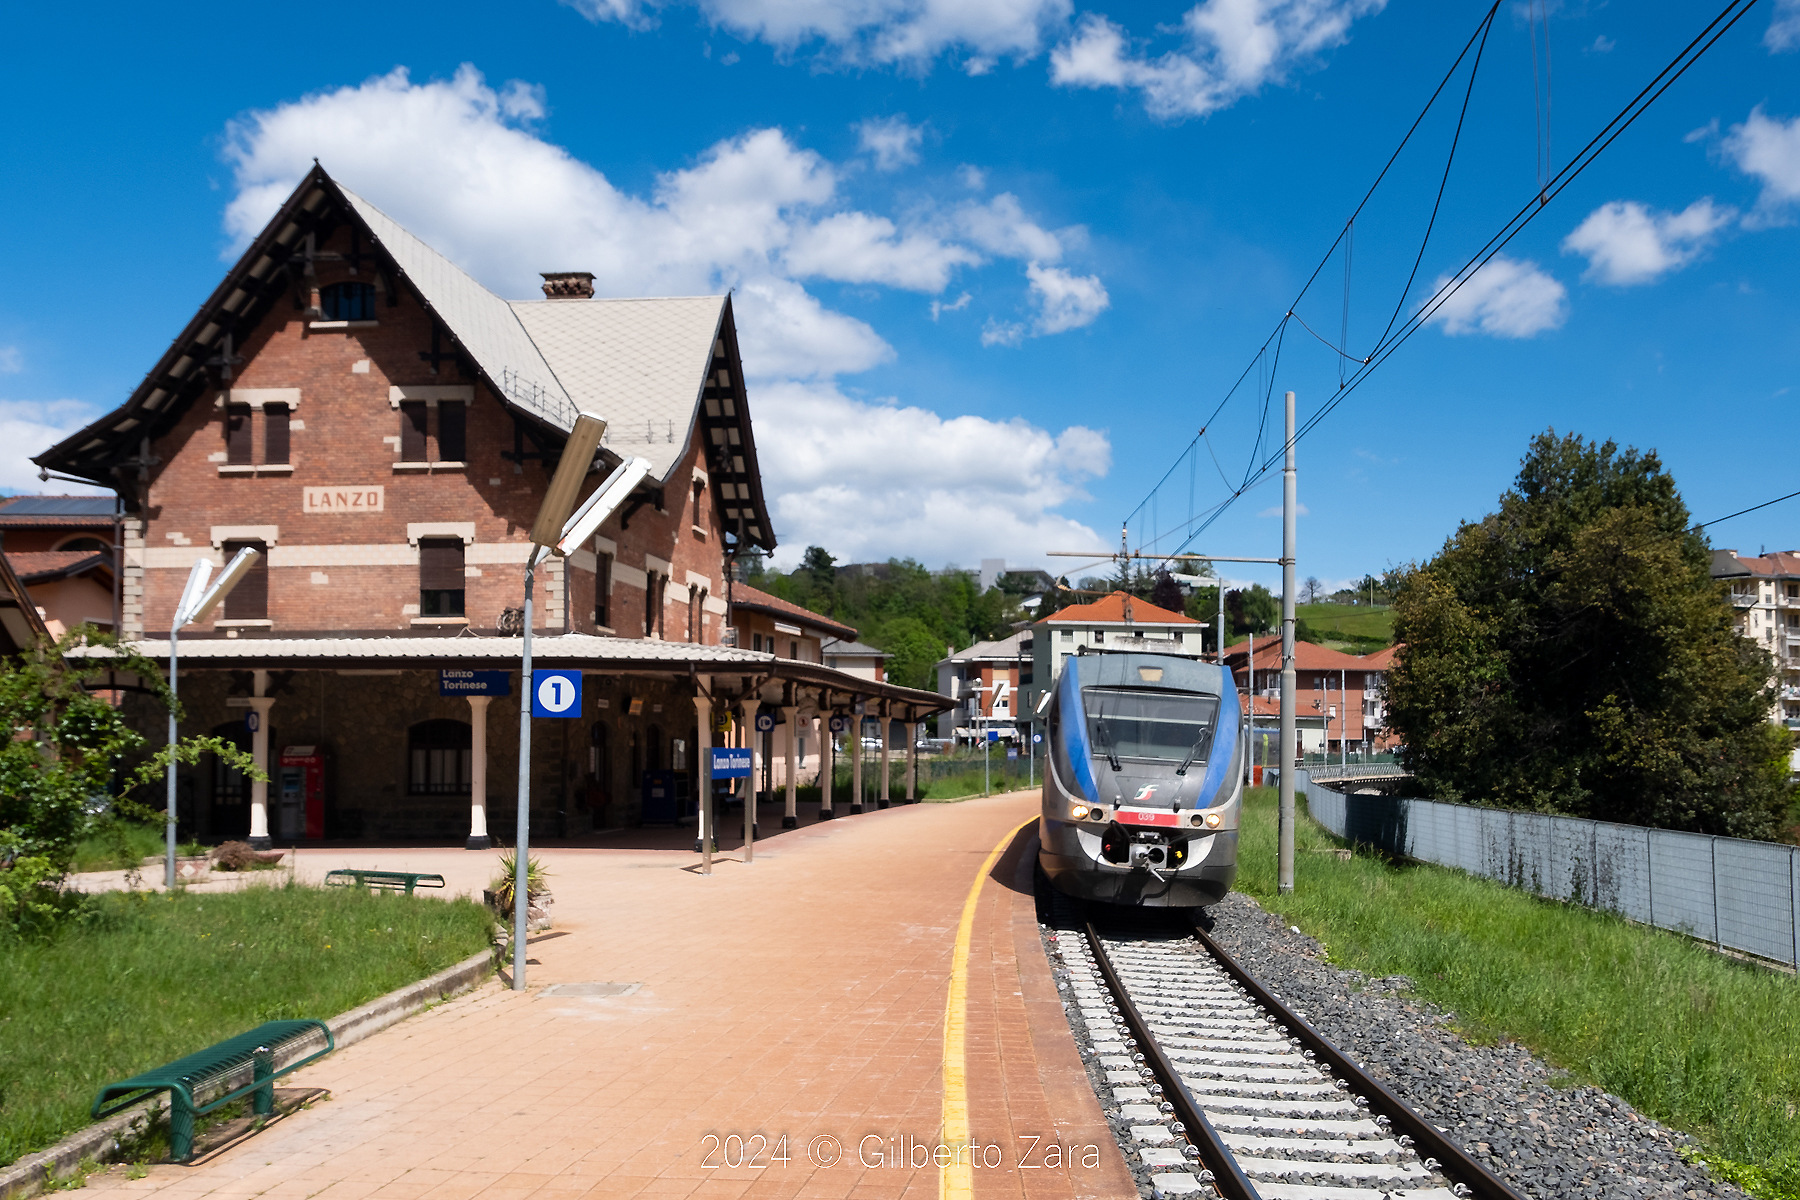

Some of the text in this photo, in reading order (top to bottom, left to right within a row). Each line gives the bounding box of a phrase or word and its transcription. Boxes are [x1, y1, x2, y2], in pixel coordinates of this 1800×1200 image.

[309, 492, 378, 507] LANZO
[442, 669, 474, 678] Lanzo
[443, 680, 487, 689] Torinese
[552, 682, 561, 705] 1
[1138, 812, 1155, 821] 039
